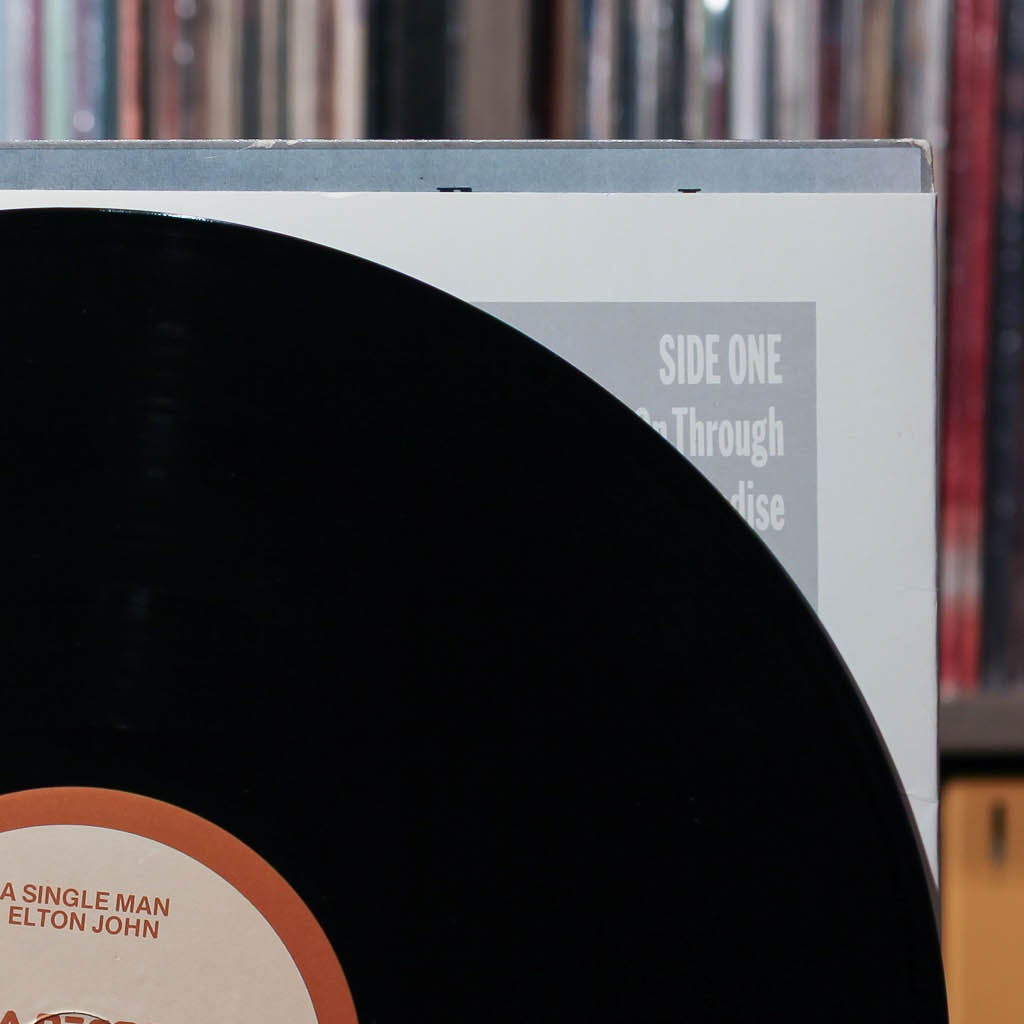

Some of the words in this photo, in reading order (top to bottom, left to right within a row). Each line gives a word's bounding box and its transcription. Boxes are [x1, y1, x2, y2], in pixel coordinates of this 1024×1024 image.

[659, 333, 721, 385] SIDE
[728, 333, 783, 385] ONE
[671, 406, 784, 468] Through
[731, 480, 785, 531] dise
[0, 882, 16, 901] A
[22, 884, 110, 910] SINGLE
[116, 894, 170, 917] MAN
[9, 906, 86, 931] ELTON
[92, 915, 159, 939] JOHN
